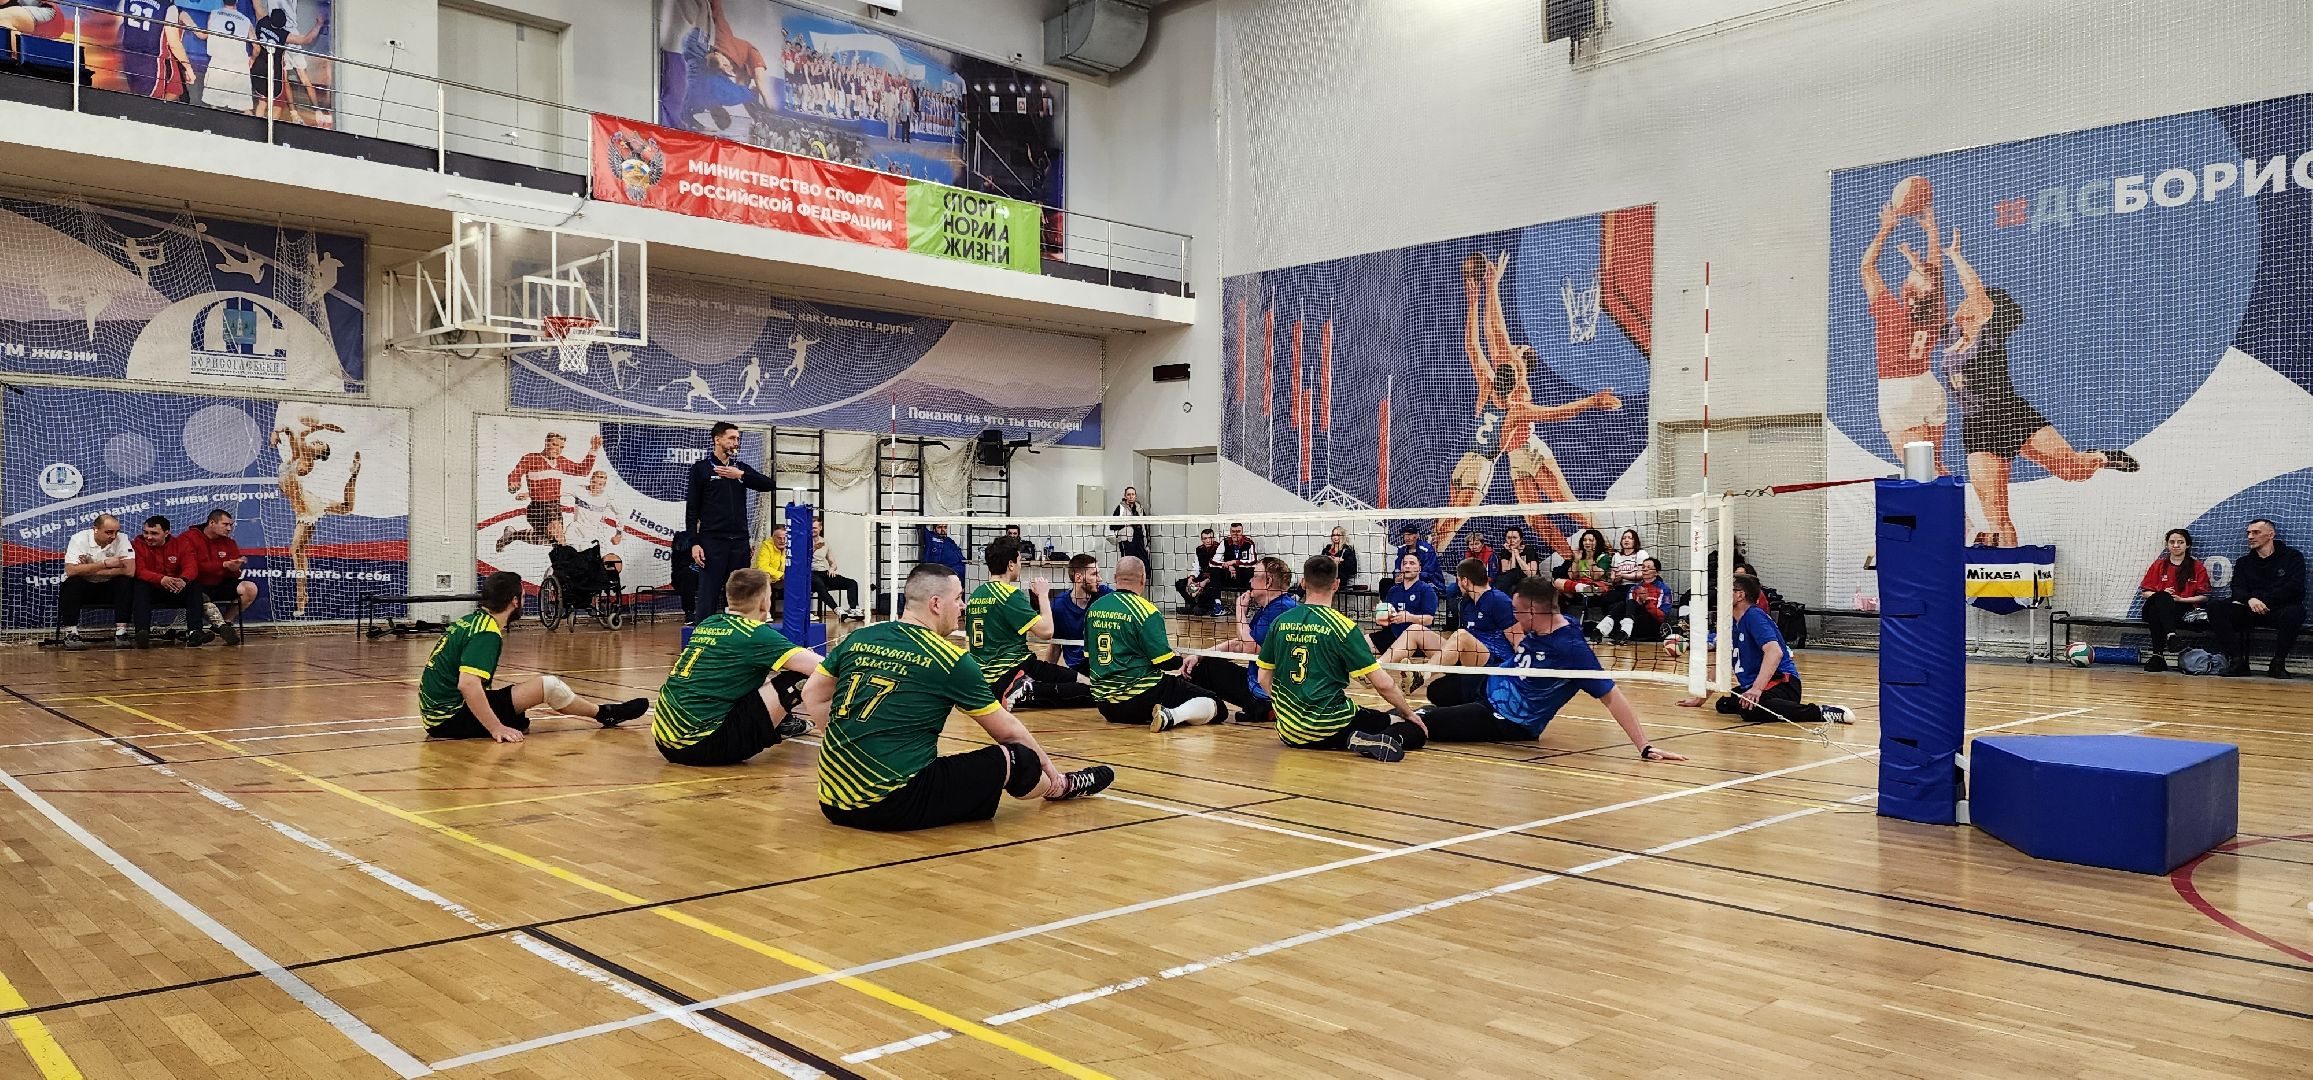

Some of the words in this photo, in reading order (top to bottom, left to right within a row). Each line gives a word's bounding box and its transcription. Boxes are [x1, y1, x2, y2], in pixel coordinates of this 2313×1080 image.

[128, 4, 153, 31] 21
[225, 21, 235, 35] 9
[688, 160, 821, 197] МИНИСТЕРСТВО
[824, 186, 885, 210] СПОРТА
[679, 180, 793, 214] РОССИЙСКОЙ
[796, 203, 893, 233] ФЕДЕРАЦИИ
[943, 191, 997, 219] СПОРТ
[943, 212, 1009, 243] НОРМА
[943, 235, 1010, 265] ЖИЗНИ
[712, 301, 730, 312] ты
[798, 313, 820, 324] как
[824, 315, 873, 329] сдаются
[874, 323, 915, 335] другие
[31, 348, 98, 361] жизни
[908, 406, 961, 423] Покажи
[965, 414, 981, 424] на
[984, 415, 1005, 425] что
[1009, 418, 1025, 428] ты
[1027, 418, 1083, 432] способен!
[19, 521, 62, 540] Будь
[65, 517, 77, 528] в
[166, 493, 209, 507] живи
[212, 489, 280, 503] спортом!
[286, 569, 341, 580] начать
[345, 571, 354, 580] с
[356, 570, 391, 582] себя
[972, 618, 985, 648] 6
[669, 646, 705, 680] 11
[1097, 632, 1114, 666] 9
[1290, 645, 1310, 685] 3
[835, 671, 901, 723] 17
